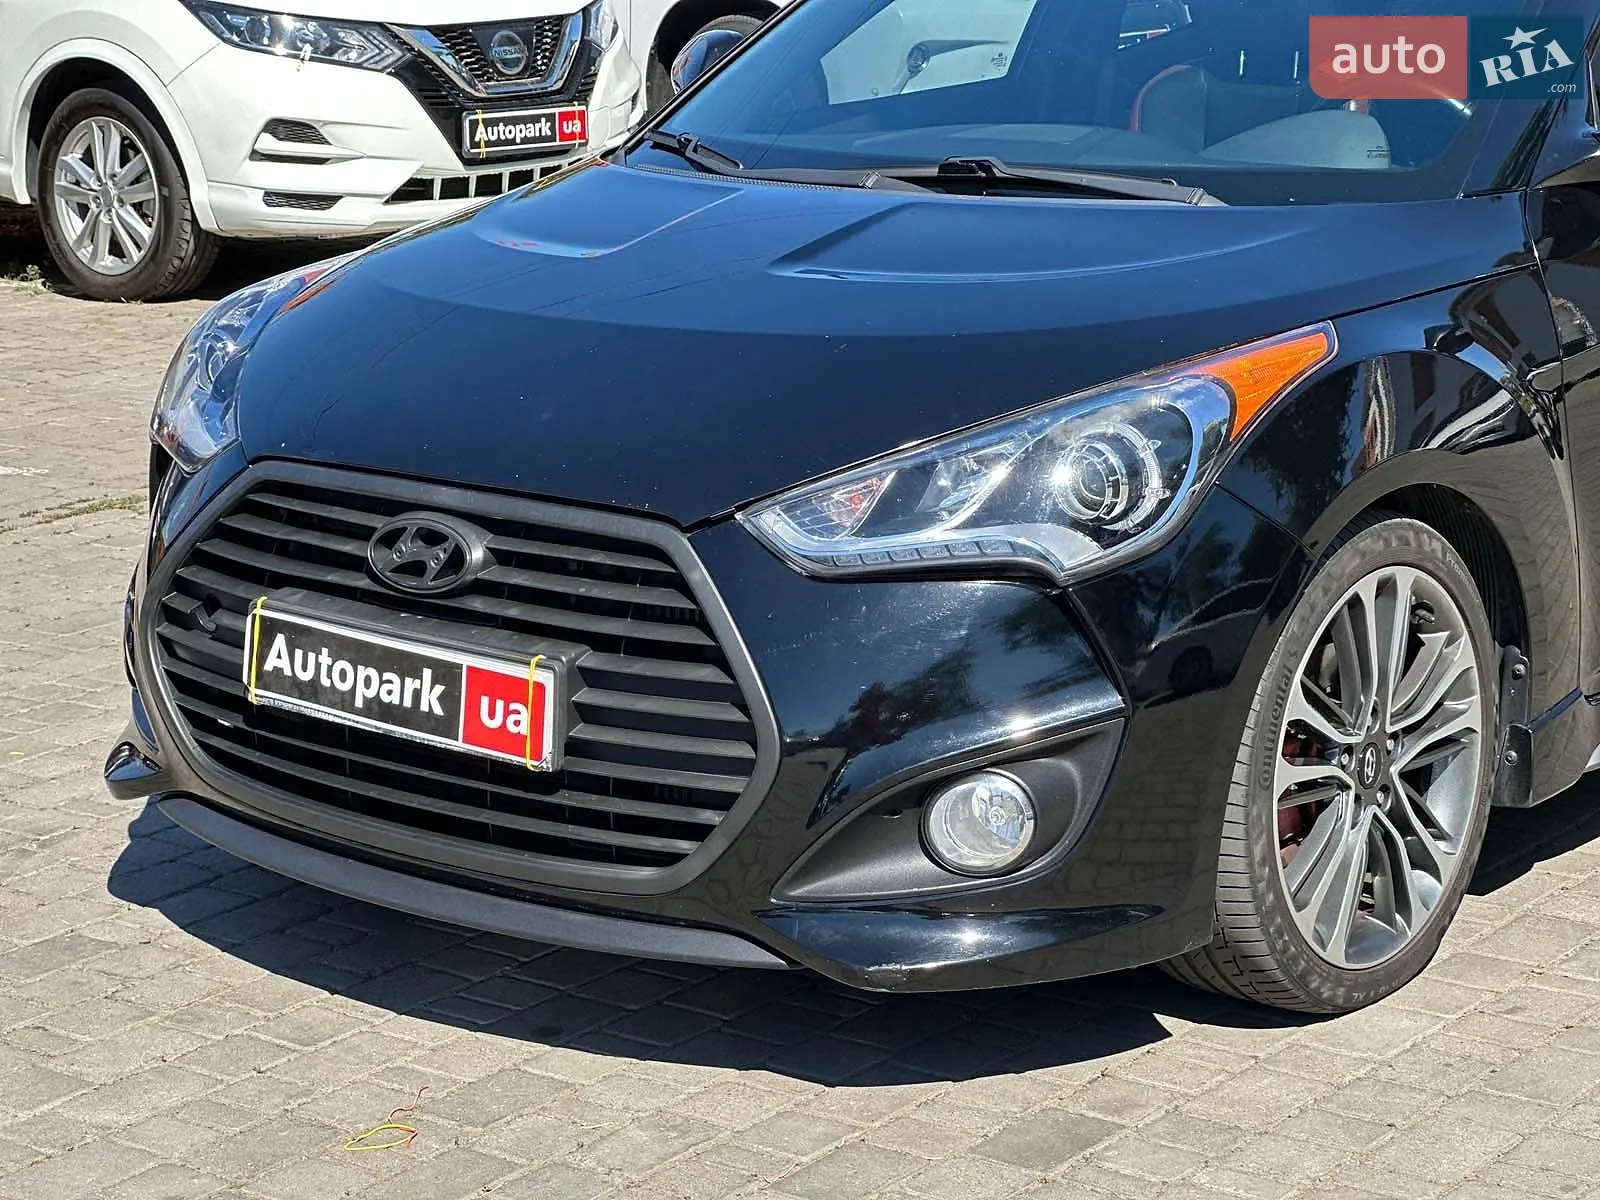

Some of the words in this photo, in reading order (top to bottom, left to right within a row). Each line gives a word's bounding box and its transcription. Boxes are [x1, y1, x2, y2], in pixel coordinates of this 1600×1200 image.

[493, 46, 523, 57] NISSAN
[474, 117, 552, 143] Autopark
[562, 119, 582, 134] ua
[263, 633, 447, 716] Autopark
[479, 695, 529, 736] ua
